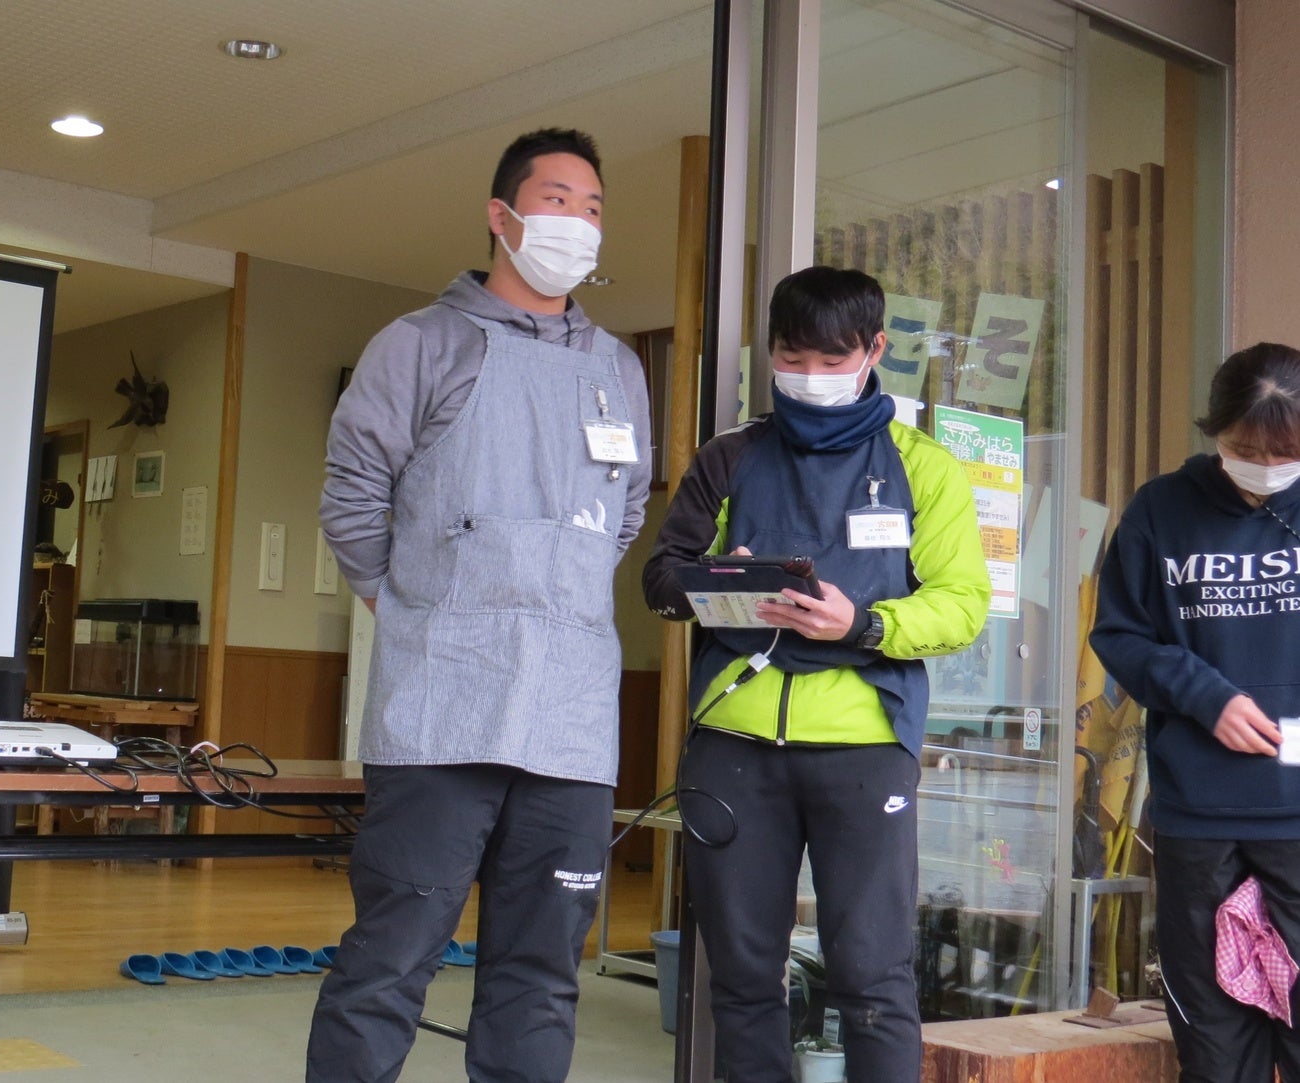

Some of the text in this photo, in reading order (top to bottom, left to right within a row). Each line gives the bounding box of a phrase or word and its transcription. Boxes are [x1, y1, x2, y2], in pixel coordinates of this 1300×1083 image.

[943, 426, 1014, 452] さがみはら
[986, 452, 1018, 468] やませみ
[1164, 547, 1300, 586] MEIS
[1201, 580, 1296, 600] EXCITING
[1179, 601, 1272, 620] HANDBALL
[889, 795, 905, 806] NIKE
[554, 869, 583, 882] HONEST
